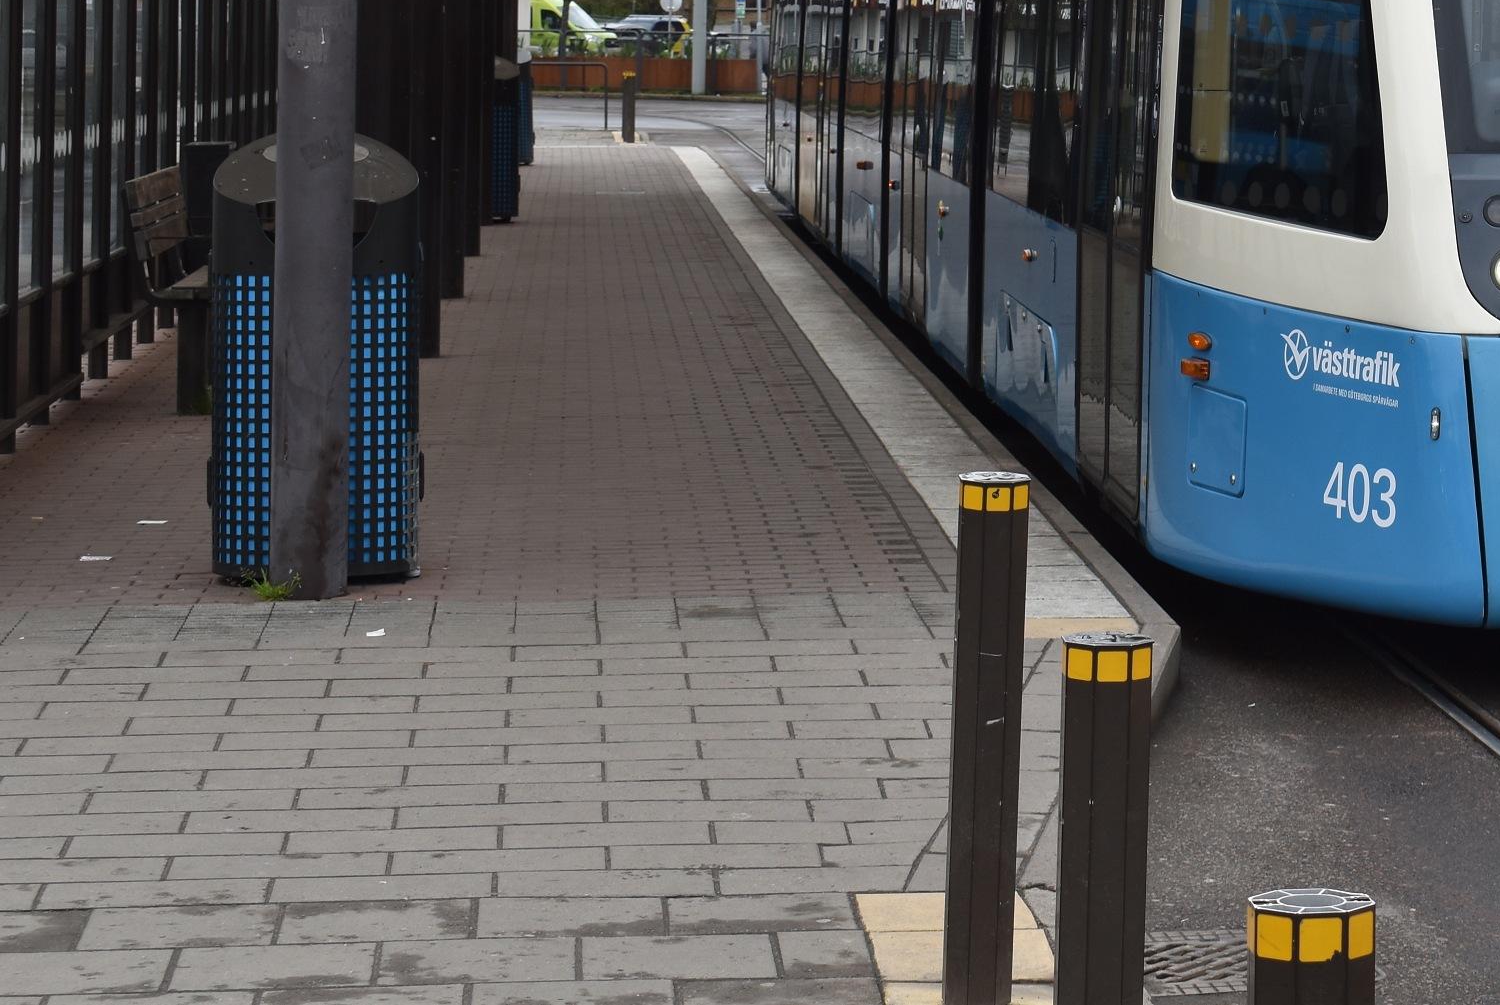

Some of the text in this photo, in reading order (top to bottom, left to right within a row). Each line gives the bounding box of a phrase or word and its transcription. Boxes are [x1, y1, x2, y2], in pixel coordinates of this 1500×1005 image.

[1312, 340, 1400, 387] västtrafik
[1338, 389, 1348, 398] MED
[1323, 461, 1397, 528] 403
